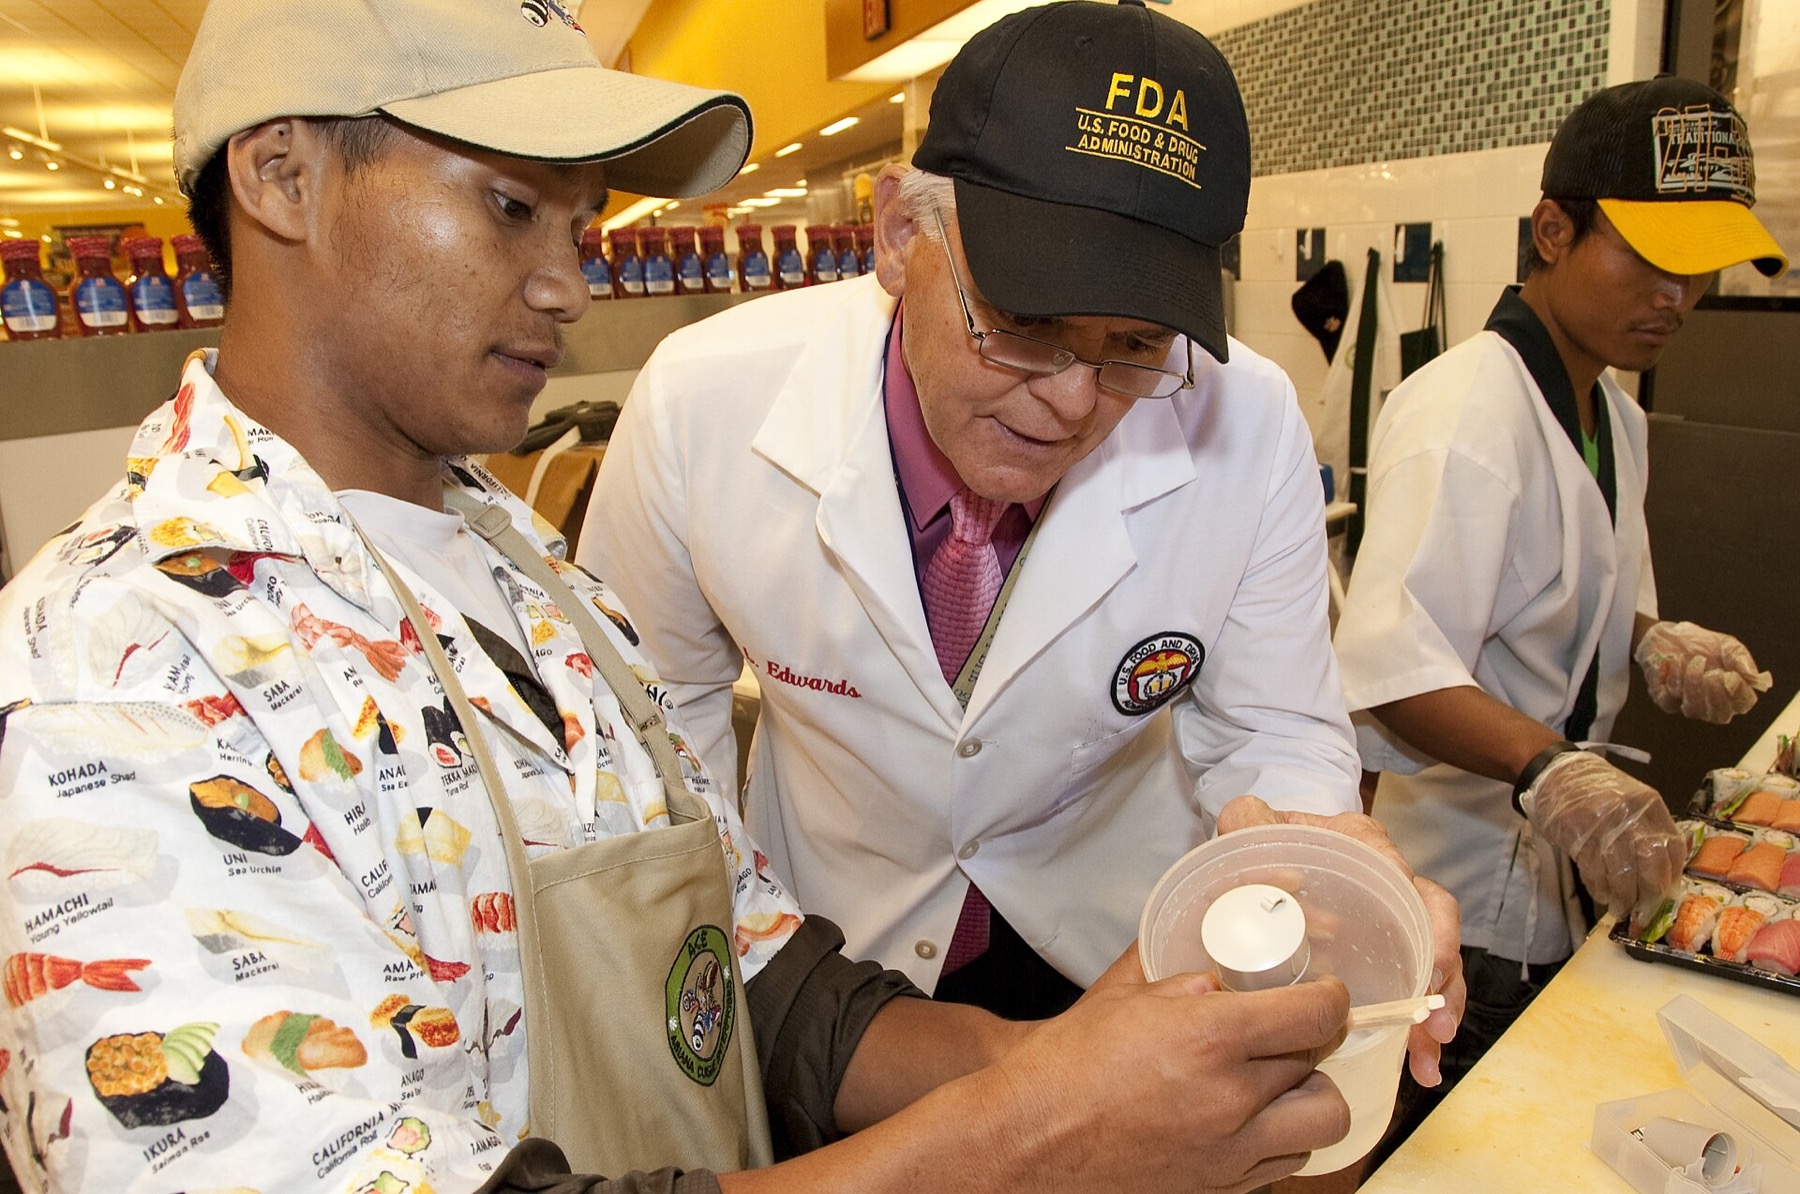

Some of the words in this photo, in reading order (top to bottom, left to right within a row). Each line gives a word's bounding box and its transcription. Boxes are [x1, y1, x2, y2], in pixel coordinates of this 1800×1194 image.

[1105, 72, 1188, 131] FDA
[1077, 115, 1105, 134] U.S.
[1108, 120, 1151, 144] FOOD
[1154, 132, 1165, 149] &
[1169, 136, 1199, 164] DRUG
[1078, 134, 1196, 180] ADMINISTRATION
[1118, 664, 1134, 685] U.S.
[1130, 643, 1157, 664] FOOD
[1161, 639, 1183, 649] AND
[262, 680, 291, 702] SABA
[766, 660, 862, 698] Edwards
[270, 686, 303, 712] Mackerel
[48, 760, 108, 787] KOHADA
[56, 779, 106, 799] Japanese
[110, 771, 136, 785] Shad
[441, 771, 462, 788] TEKKA
[222, 853, 248, 866] UNI
[228, 867, 247, 877] Sea
[249, 865, 282, 874] Urchin
[25, 893, 89, 934] HAMACHI
[30, 922, 61, 945] Young
[63, 897, 114, 927] Yellowtail
[232, 951, 267, 971] SABA
[235, 962, 280, 982] Mackerel
[385, 974, 407, 983] Raw
[401, 1068, 425, 1088] ANAGO
[143, 1127, 186, 1163] IKURA
[152, 1146, 189, 1175] Salmon
[190, 1130, 210, 1149] Roe
[312, 1111, 385, 1166] CALIFORNIA
[317, 1145, 358, 1179] California
[360, 1130, 378, 1149] Roll
